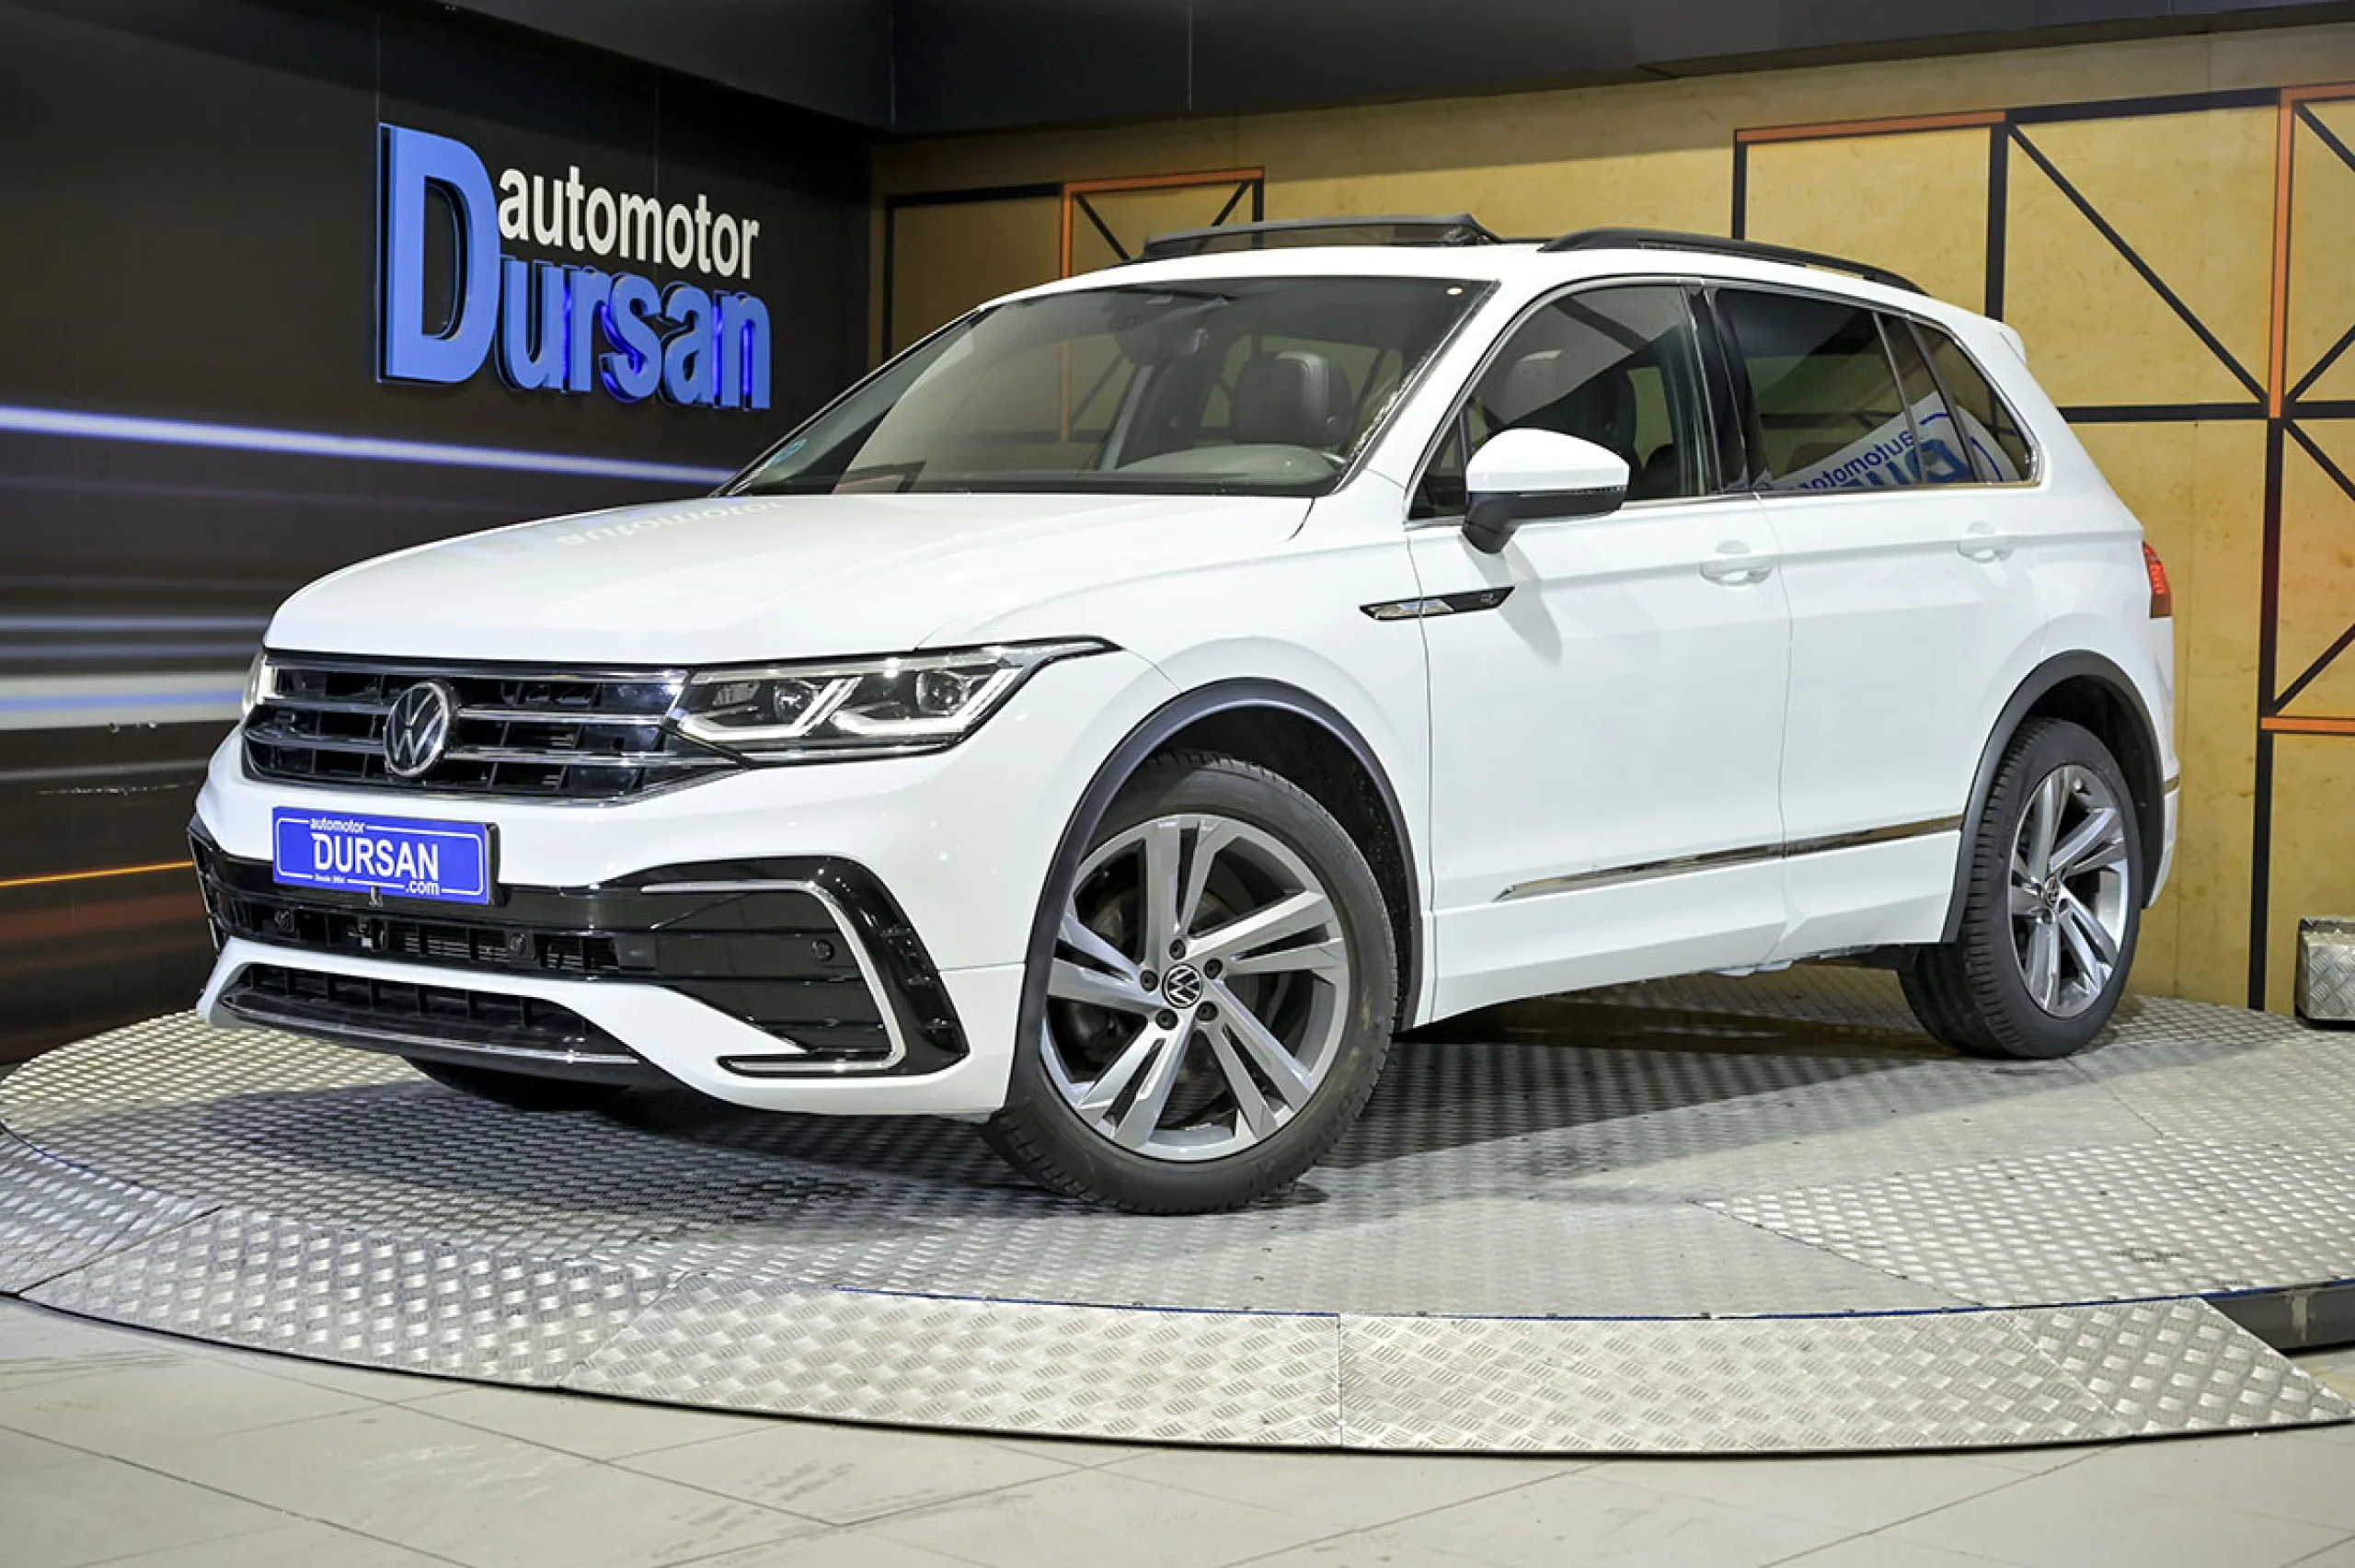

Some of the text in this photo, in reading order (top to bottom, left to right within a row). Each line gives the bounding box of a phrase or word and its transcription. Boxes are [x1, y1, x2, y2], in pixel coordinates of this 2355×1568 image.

[498, 165, 761, 280] automotor
[378, 122, 771, 411] Dursan
[309, 816, 366, 834] automotor
[310, 831, 439, 881] DURSAN
[405, 878, 441, 896] .com
